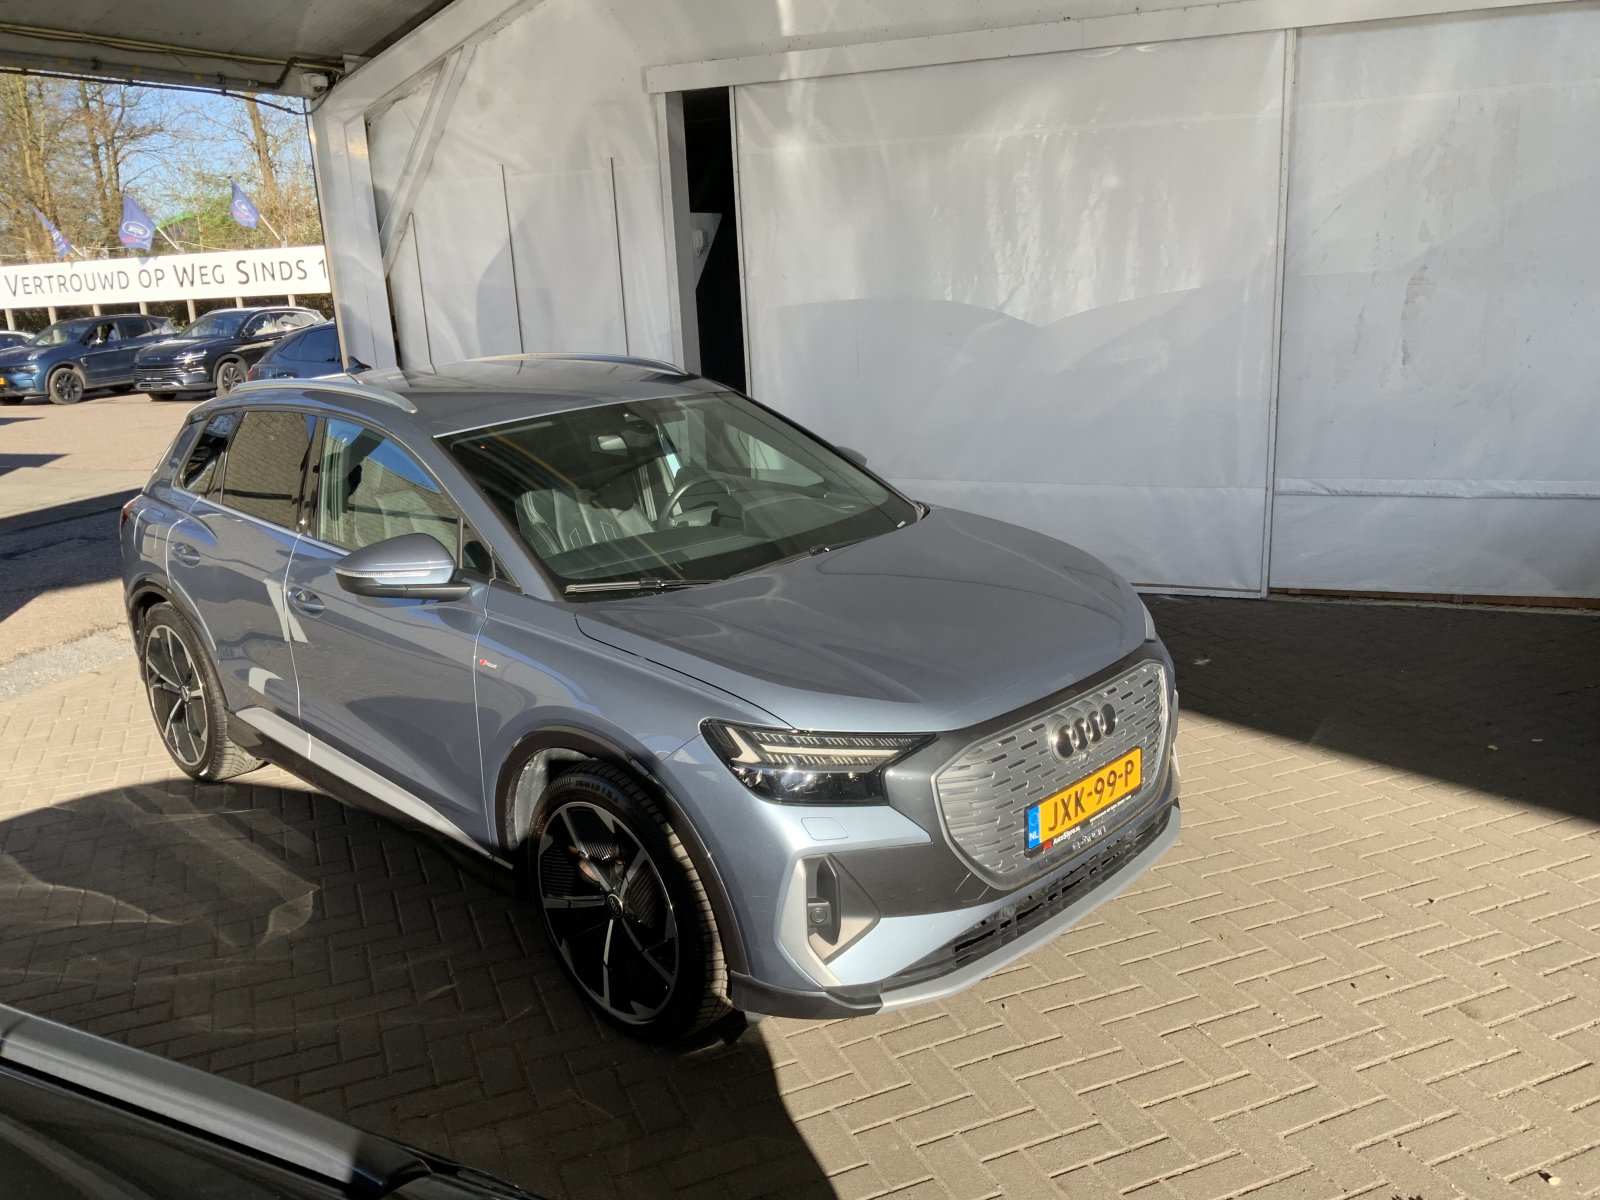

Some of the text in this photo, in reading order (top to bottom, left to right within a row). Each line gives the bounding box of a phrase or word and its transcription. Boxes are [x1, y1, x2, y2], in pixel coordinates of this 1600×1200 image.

[236, 259, 307, 285] SINDS
[1048, 759, 1135, 832] JXK-99-P
[1028, 830, 1039, 842] NL
